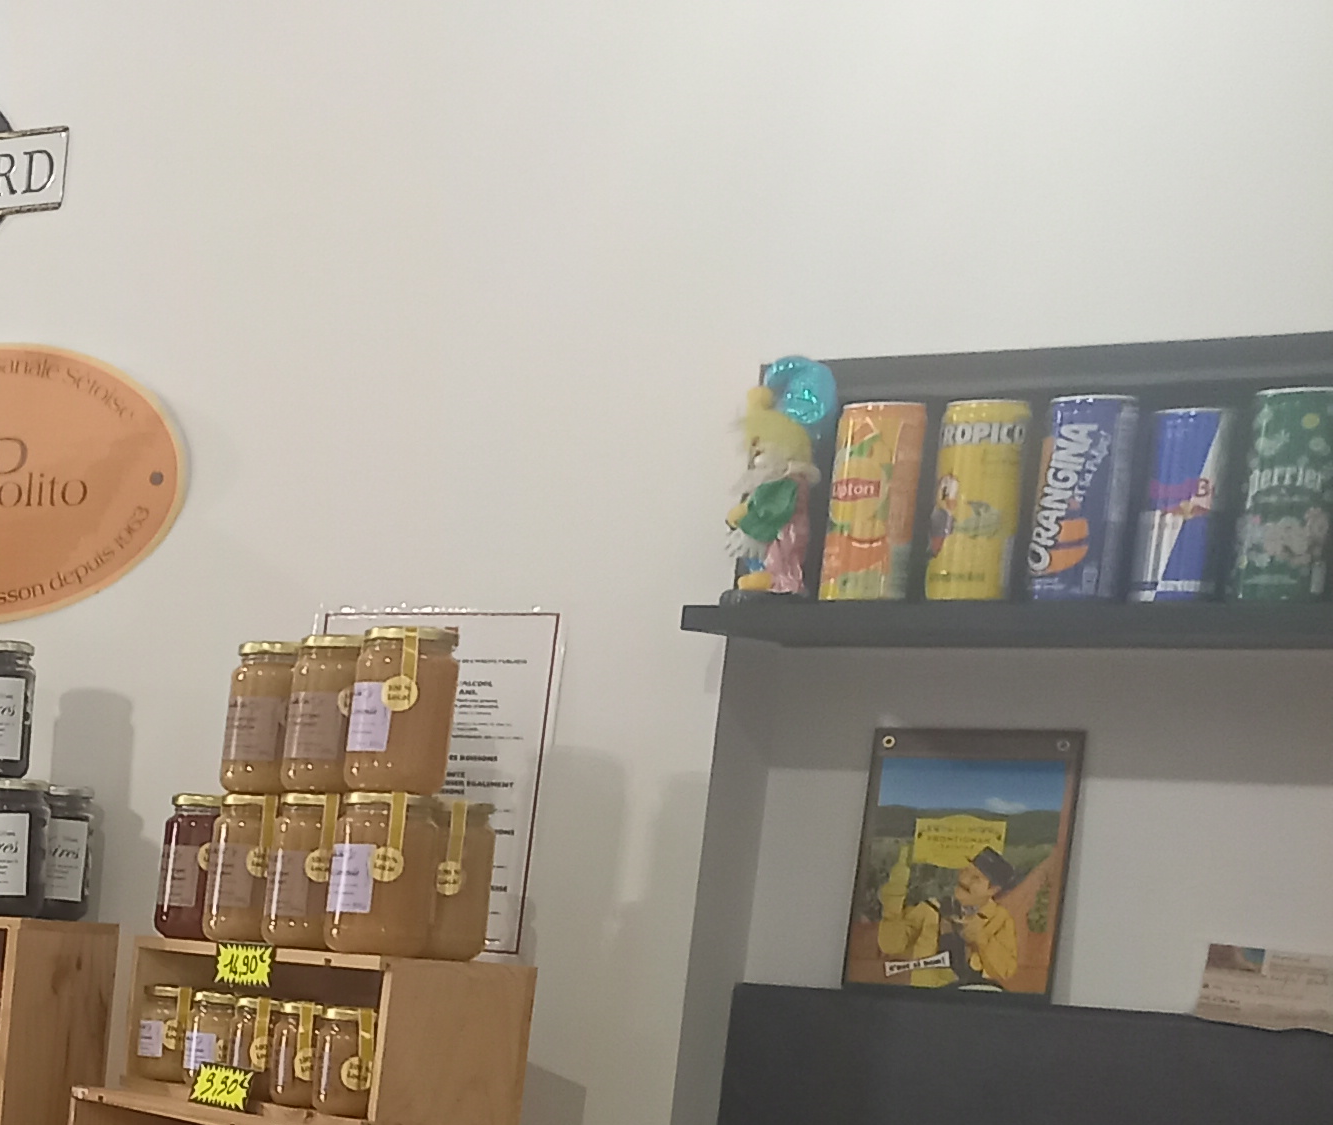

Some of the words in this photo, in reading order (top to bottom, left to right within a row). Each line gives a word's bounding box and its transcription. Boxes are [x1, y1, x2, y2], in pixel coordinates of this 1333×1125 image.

[64, 363, 134, 421] Sétoise
[1026, 421, 1099, 576] ORANGINA
[48, 542, 116, 595] depuis
[51, 844, 80, 859] ires
[203, 1070, 250, 1096] 9,90€
